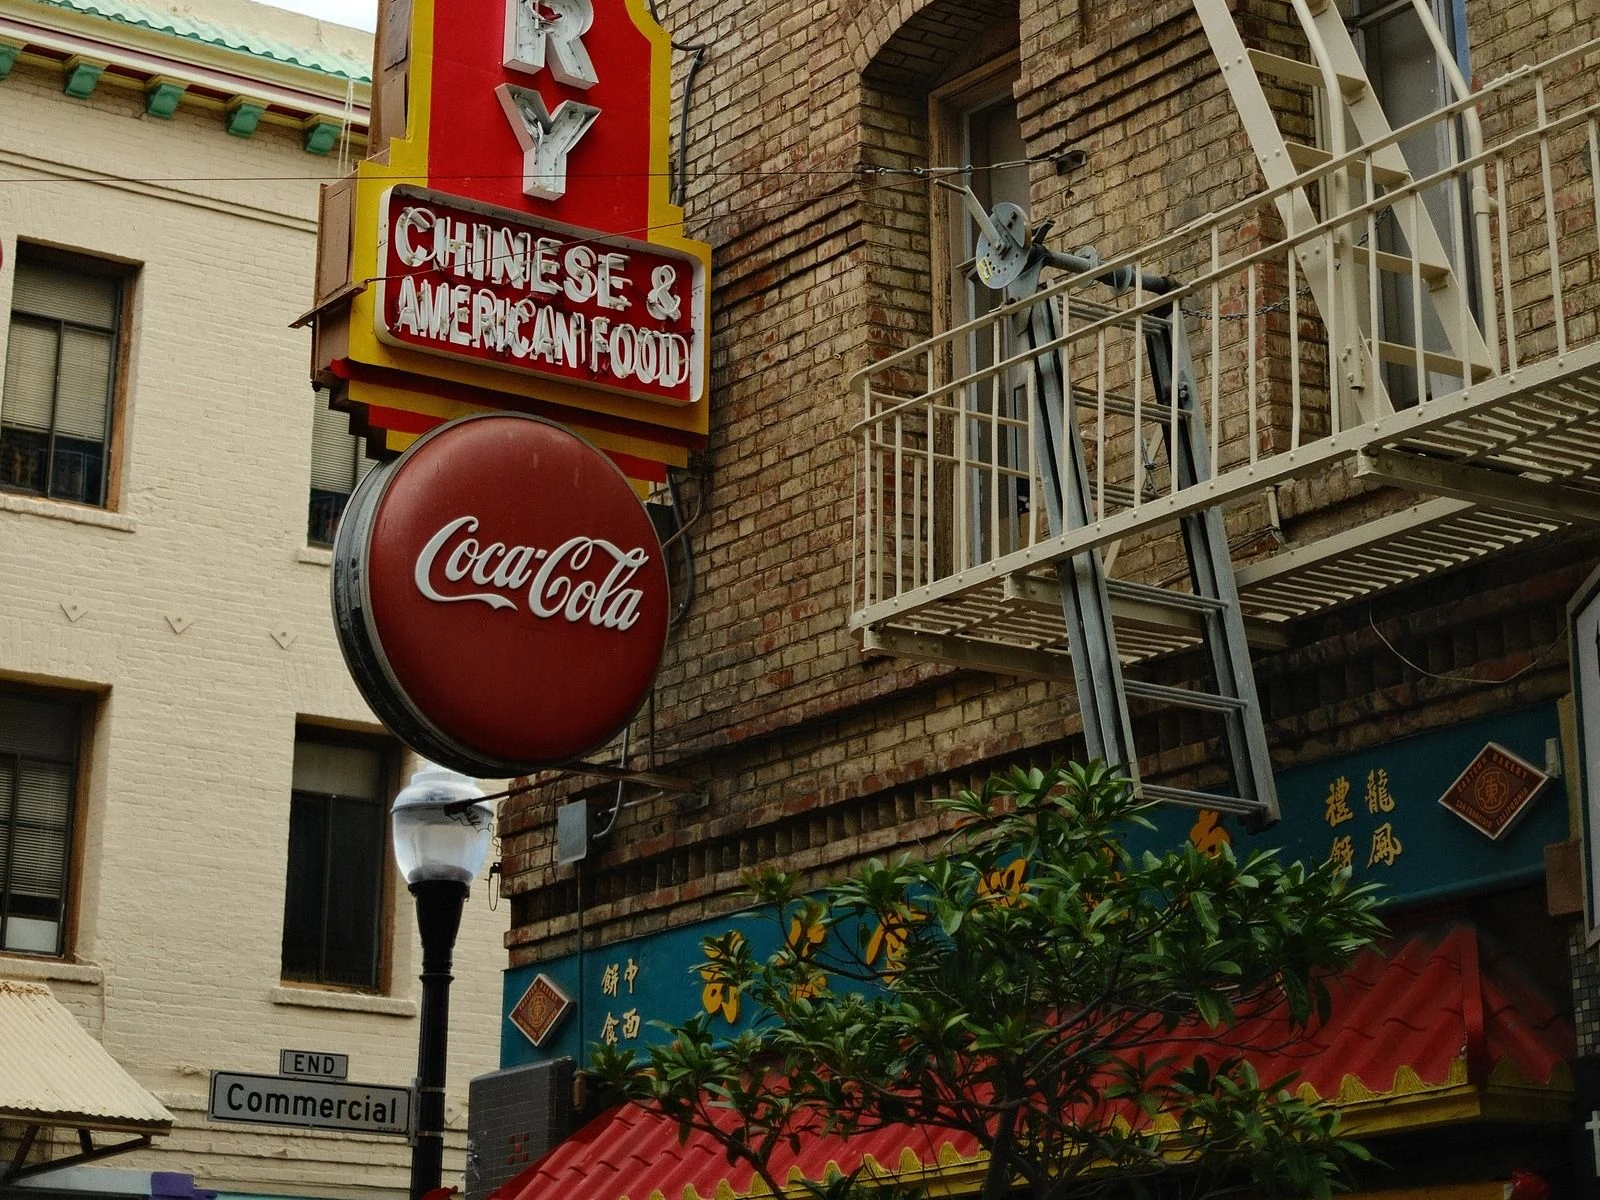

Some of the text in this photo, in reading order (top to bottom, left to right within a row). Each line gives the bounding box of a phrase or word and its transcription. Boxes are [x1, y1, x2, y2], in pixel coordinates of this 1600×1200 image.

[395, 206, 681, 322] CHINESE &
[395, 275, 689, 388] AMERICAN FOOD
[414, 515, 649, 631] Coca-Cola
[227, 1083, 397, 1124] Commercial
[294, 1054, 335, 1075] END
